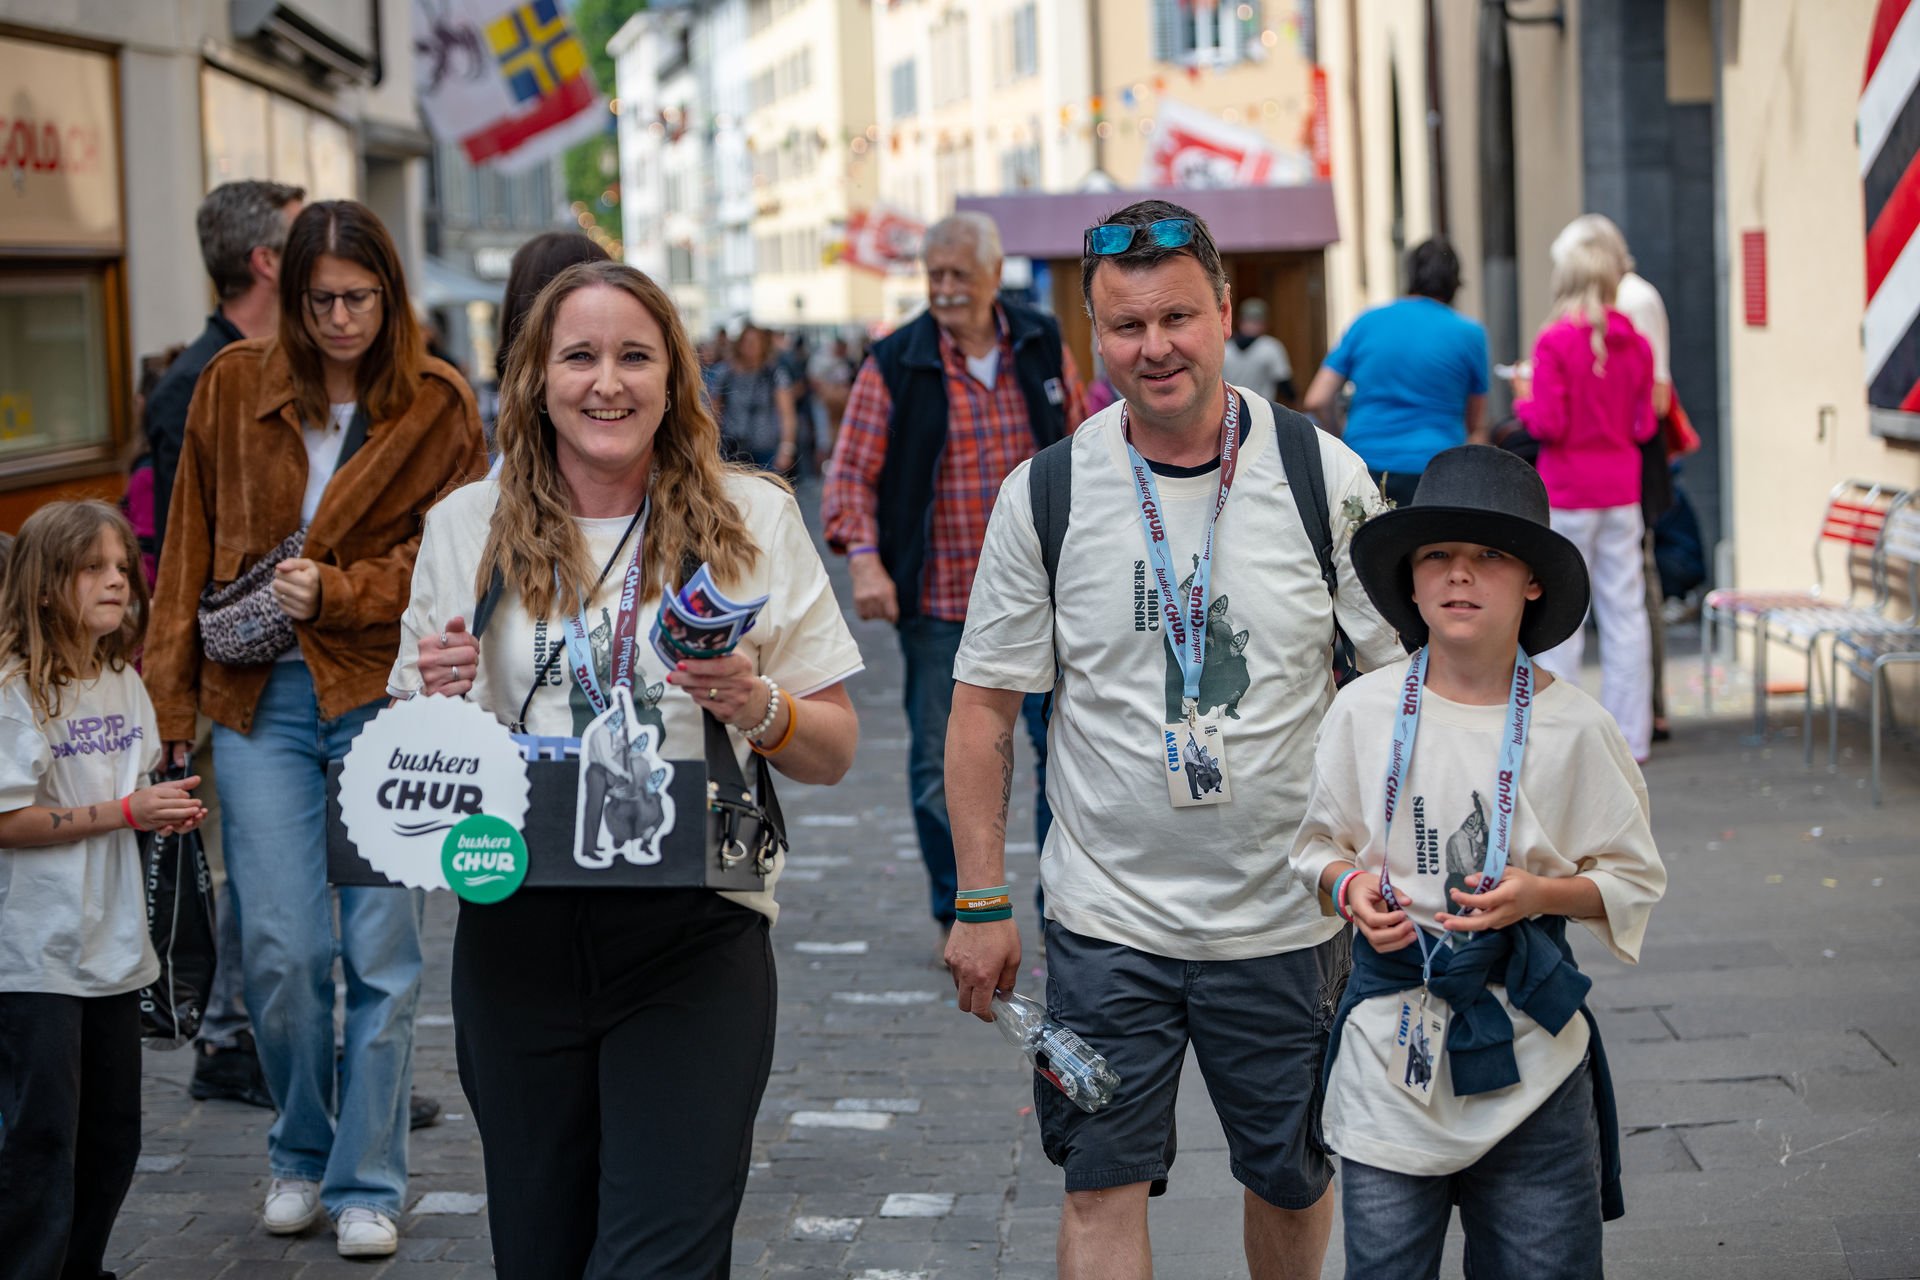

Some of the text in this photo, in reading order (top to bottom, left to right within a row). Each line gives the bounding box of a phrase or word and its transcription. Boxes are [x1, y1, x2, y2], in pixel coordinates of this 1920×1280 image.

[1134, 559, 1146, 632] BUSKERS
[1147, 588, 1159, 632] CHUR
[388, 747, 480, 775] buskers
[1164, 730, 1180, 772] CREW
[376, 778, 484, 815] CHUR
[457, 834, 511, 849] buskers
[1412, 795, 1428, 875] BUSKERS
[1427, 828, 1440, 875] CHUR
[452, 851, 516, 872] CHUR
